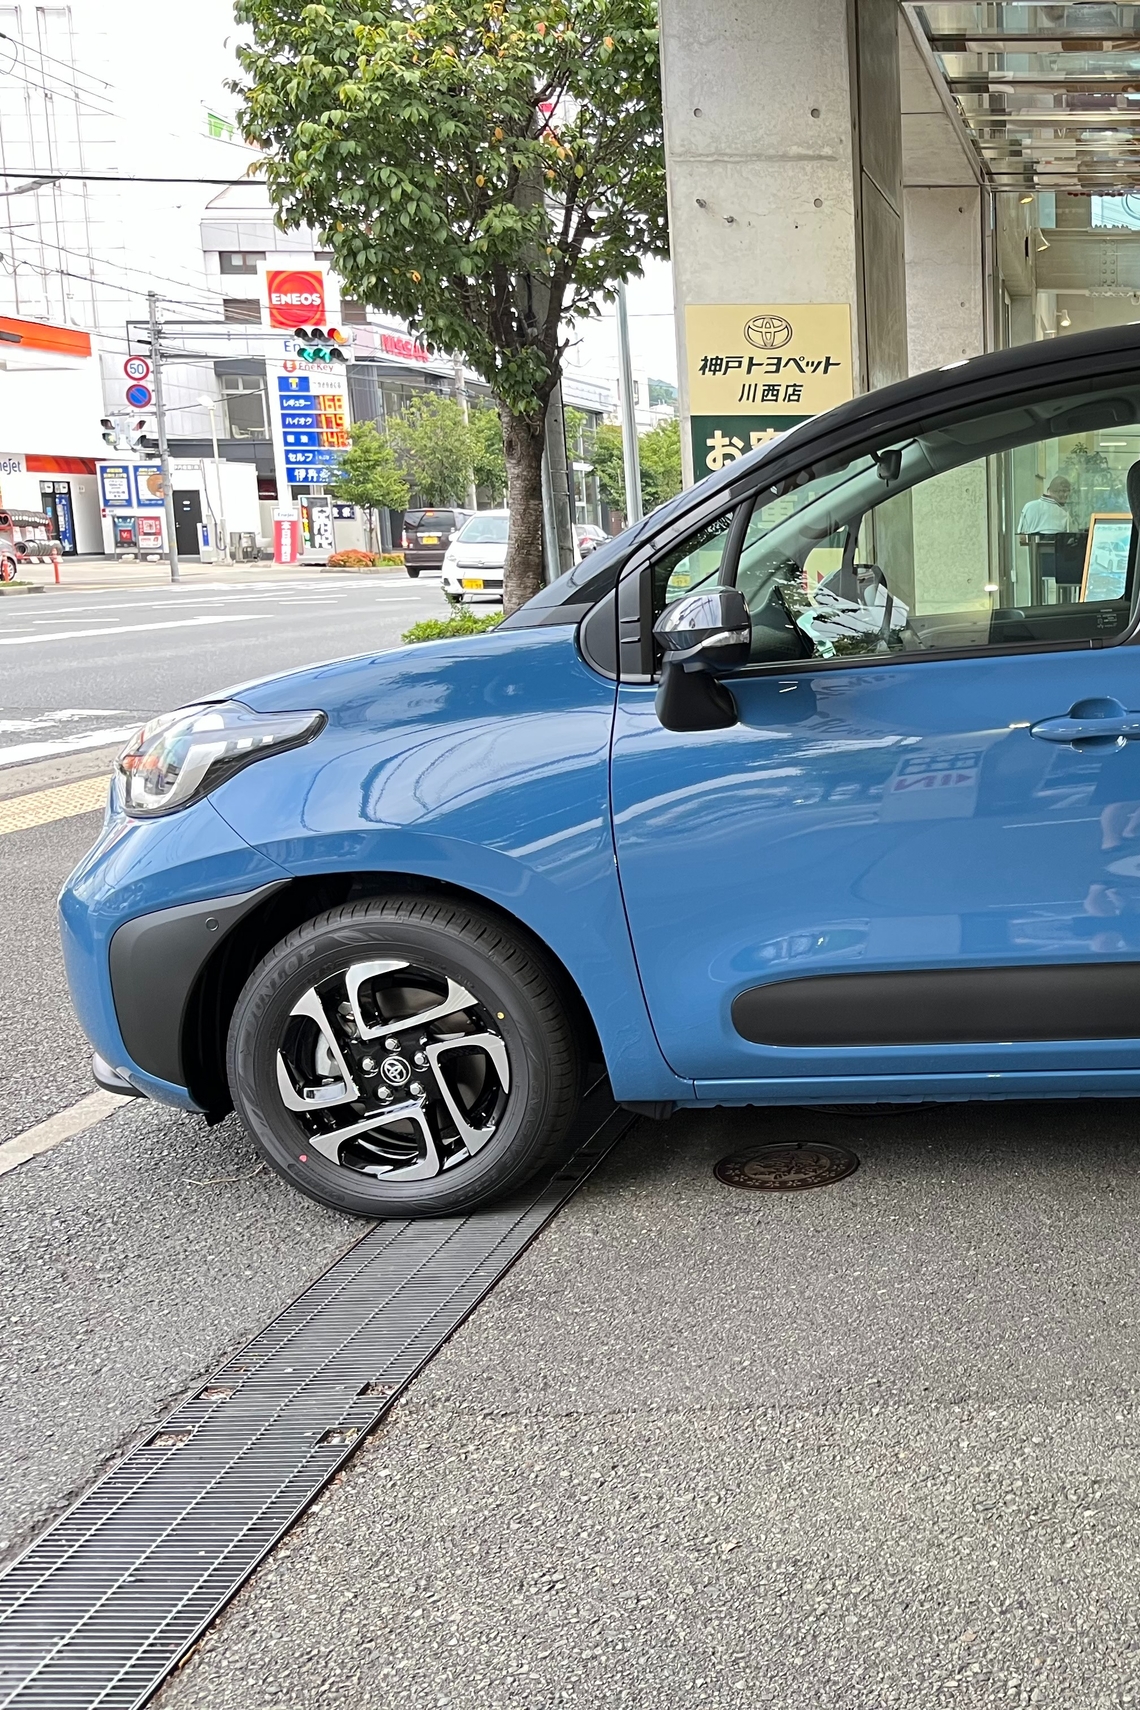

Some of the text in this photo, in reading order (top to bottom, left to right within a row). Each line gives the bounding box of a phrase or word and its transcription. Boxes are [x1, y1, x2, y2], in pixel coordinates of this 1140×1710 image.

[271, 293, 321, 306] ENEOS
[129, 363, 145, 375] 50
[298, 362, 334, 372] EneKey
[698, 355, 842, 376] 神戸トヨペット
[738, 383, 804, 403] 川西店
[283, 399, 311, 407] レギュラー
[285, 416, 313, 425] ハイオク
[288, 452, 313, 461] セルフ
